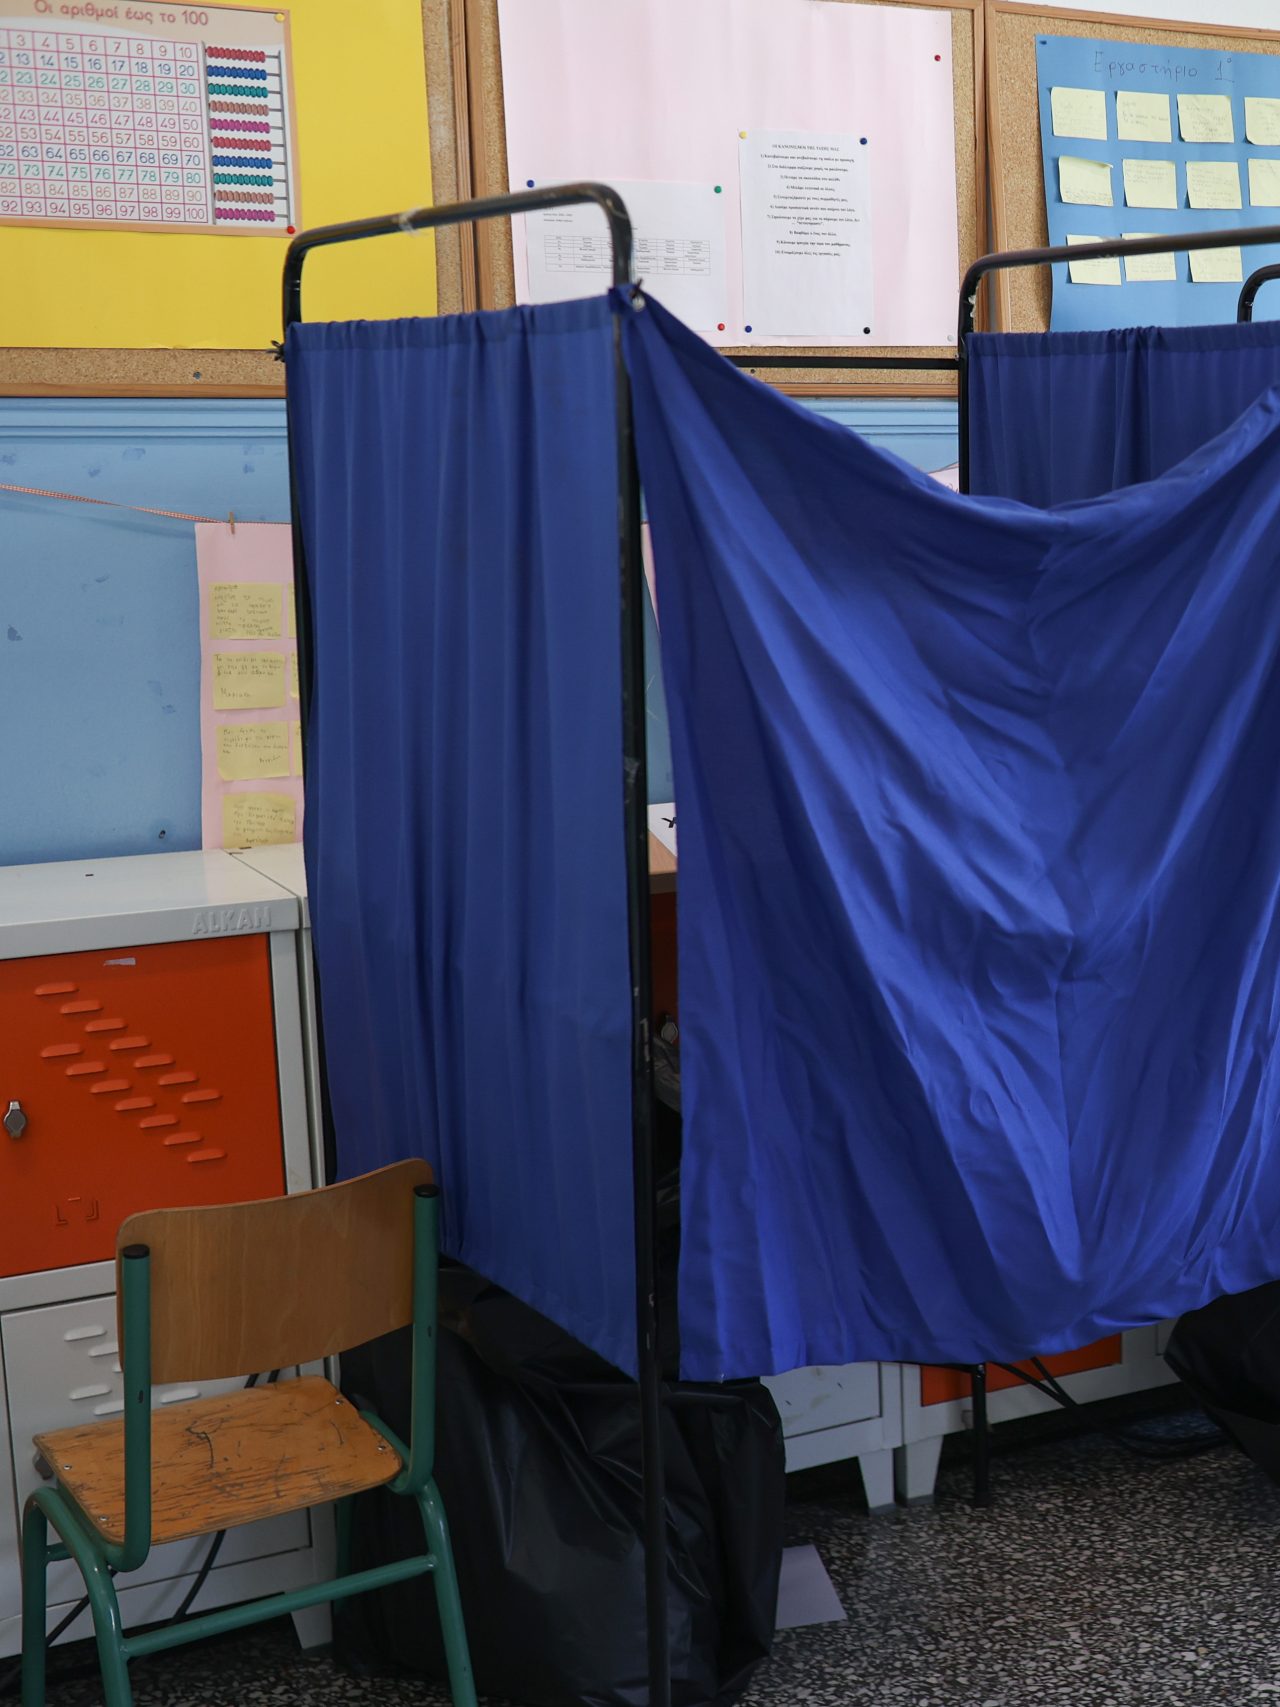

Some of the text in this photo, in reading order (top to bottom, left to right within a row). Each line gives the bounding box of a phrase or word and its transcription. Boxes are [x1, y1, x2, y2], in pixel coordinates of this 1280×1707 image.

[34, 0, 208, 26] Οι αριθμοί έως το 100
[16, 34, 192, 58] 3 4 5 6 7 8 9 10
[16, 53, 30, 65] 13
[40, 55, 54, 66] 14
[64, 56, 78, 69] 15
[88, 58, 102, 70] 16
[112, 60, 125, 72] 17
[135, 62, 148, 74] 18
[158, 63, 171, 75] 19
[179, 65, 195, 77] 20
[1094, 51, 1198, 82] Εργαστήριο
[16, 71, 33, 84] 23
[40, 72, 57, 85] 24
[64, 74, 81, 87] 25
[87, 76, 104, 88] 26
[111, 78, 128, 90] 27
[135, 80, 151, 91] 28
[158, 81, 174, 93] 29
[180, 82, 196, 94] 30
[17, 90, 34, 103] 33
[41, 91, 58, 104] 34
[65, 93, 82, 105] 35
[88, 94, 106, 106] 36
[113, 96, 128, 108] 37
[136, 98, 152, 110] 38
[159, 99, 175, 111] 39
[182, 100, 198, 113] 40
[19, 109, 36, 121] 43
[44, 110, 60, 122] 44
[67, 112, 84, 124] 45
[91, 113, 107, 125] 46
[114, 115, 130, 126] 47
[138, 116, 153, 128] 48
[160, 118, 176, 129] 49
[183, 119, 198, 130] 50
[20, 127, 37, 140] 53
[45, 129, 61, 140] 54
[69, 130, 85, 142] 55
[92, 131, 108, 144] 56
[116, 133, 132, 144] 57
[139, 134, 154, 146] 58
[162, 136, 177, 147] 59
[184, 137, 199, 148] 60
[21, 146, 39, 158] 63
[46, 147, 62, 159] 64
[69, 148, 86, 160] 65
[93, 150, 110, 161] 66
[116, 151, 133, 162] 67
[140, 152, 156, 164] 68
[163, 154, 178, 165] 69
[184, 155, 200, 166] 70
[24, 164, 40, 176] 73
[48, 166, 64, 177] 74
[71, 167, 88, 179] 75
[94, 168, 111, 179] 76
[118, 169, 134, 180] 77
[141, 170, 156, 182] 78
[164, 172, 179, 182] 79
[186, 172, 200, 184] 80
[0, 181, 202, 201] 82 83 84 85 86 87 88 89 90
[1, 200, 204, 219] 92 93 94 95 96 97 98 99 100
[192, 906, 272, 935] ALKAN
